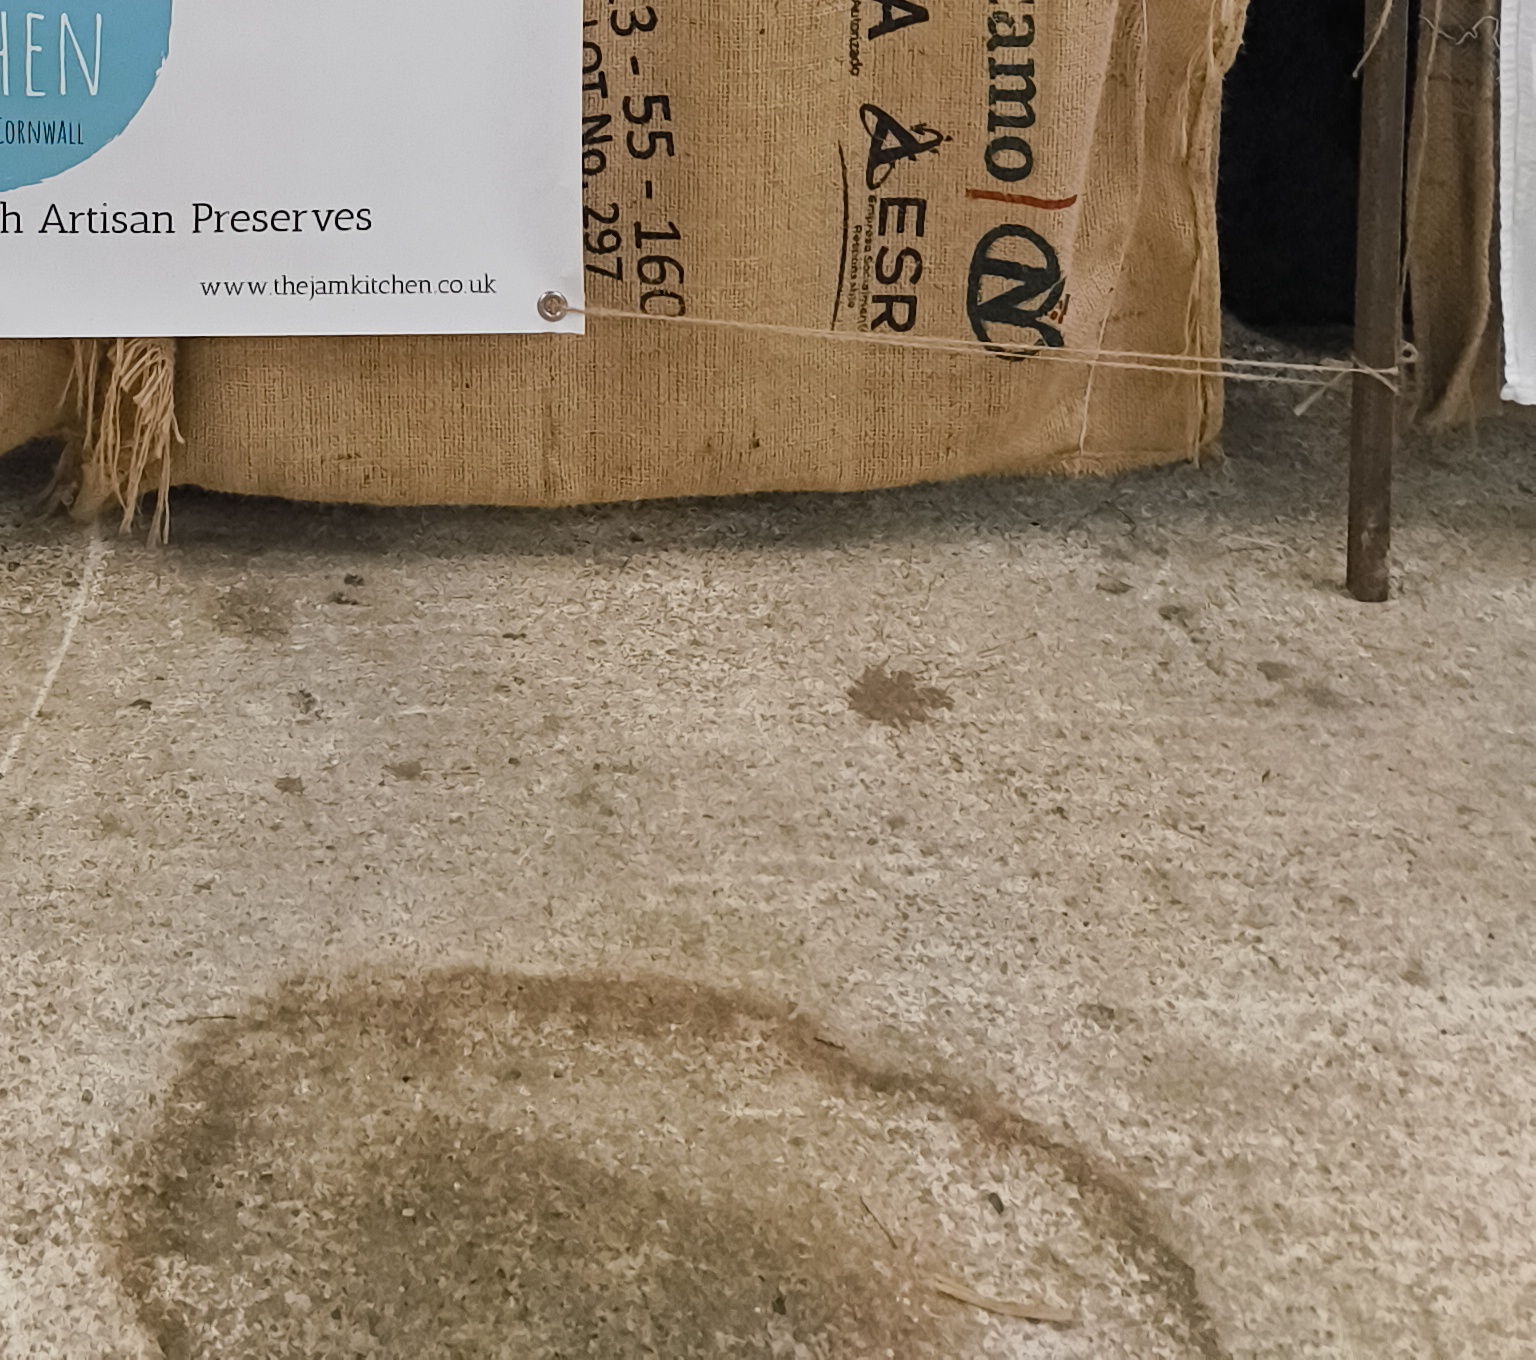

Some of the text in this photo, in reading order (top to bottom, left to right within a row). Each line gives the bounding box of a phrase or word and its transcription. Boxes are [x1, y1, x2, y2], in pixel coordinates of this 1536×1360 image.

[622, 93, 676, 160] 55
[38, 202, 175, 235] Artisan
[192, 202, 373, 235] Preserves
[585, 202, 624, 281] 297
[200, 273, 497, 301] www.thejamkitchen.co.uk
[632, 220, 686, 319] 160
[871, 197, 927, 332] ESR
